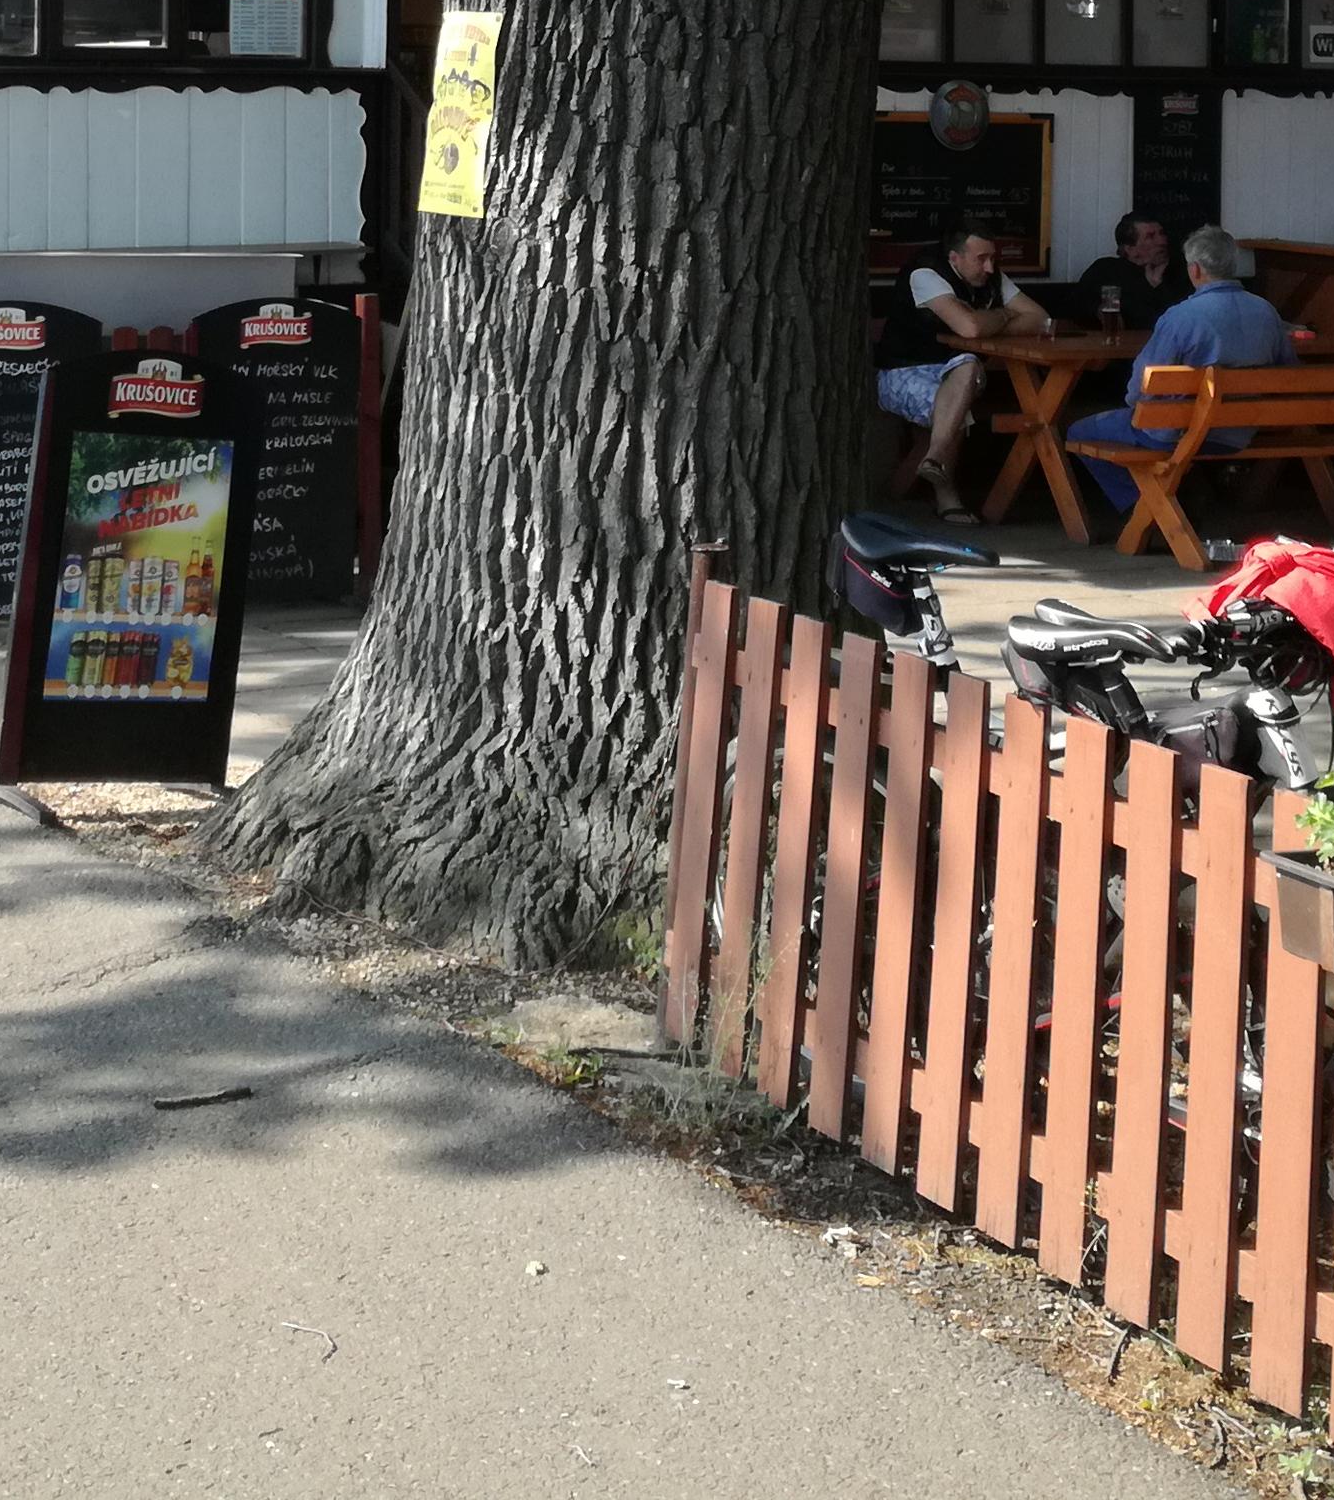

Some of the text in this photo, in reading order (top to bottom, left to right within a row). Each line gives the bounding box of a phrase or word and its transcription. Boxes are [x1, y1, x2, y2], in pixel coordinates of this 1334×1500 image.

[244, 321, 308, 337] KRUŠOVICE
[313, 364, 339, 379] VLK
[115, 381, 198, 407] KRUŠOVICE
[86, 446, 218, 495] OSVĚŽUJÍCÍ
[97, 502, 200, 540] NABÍDKA
